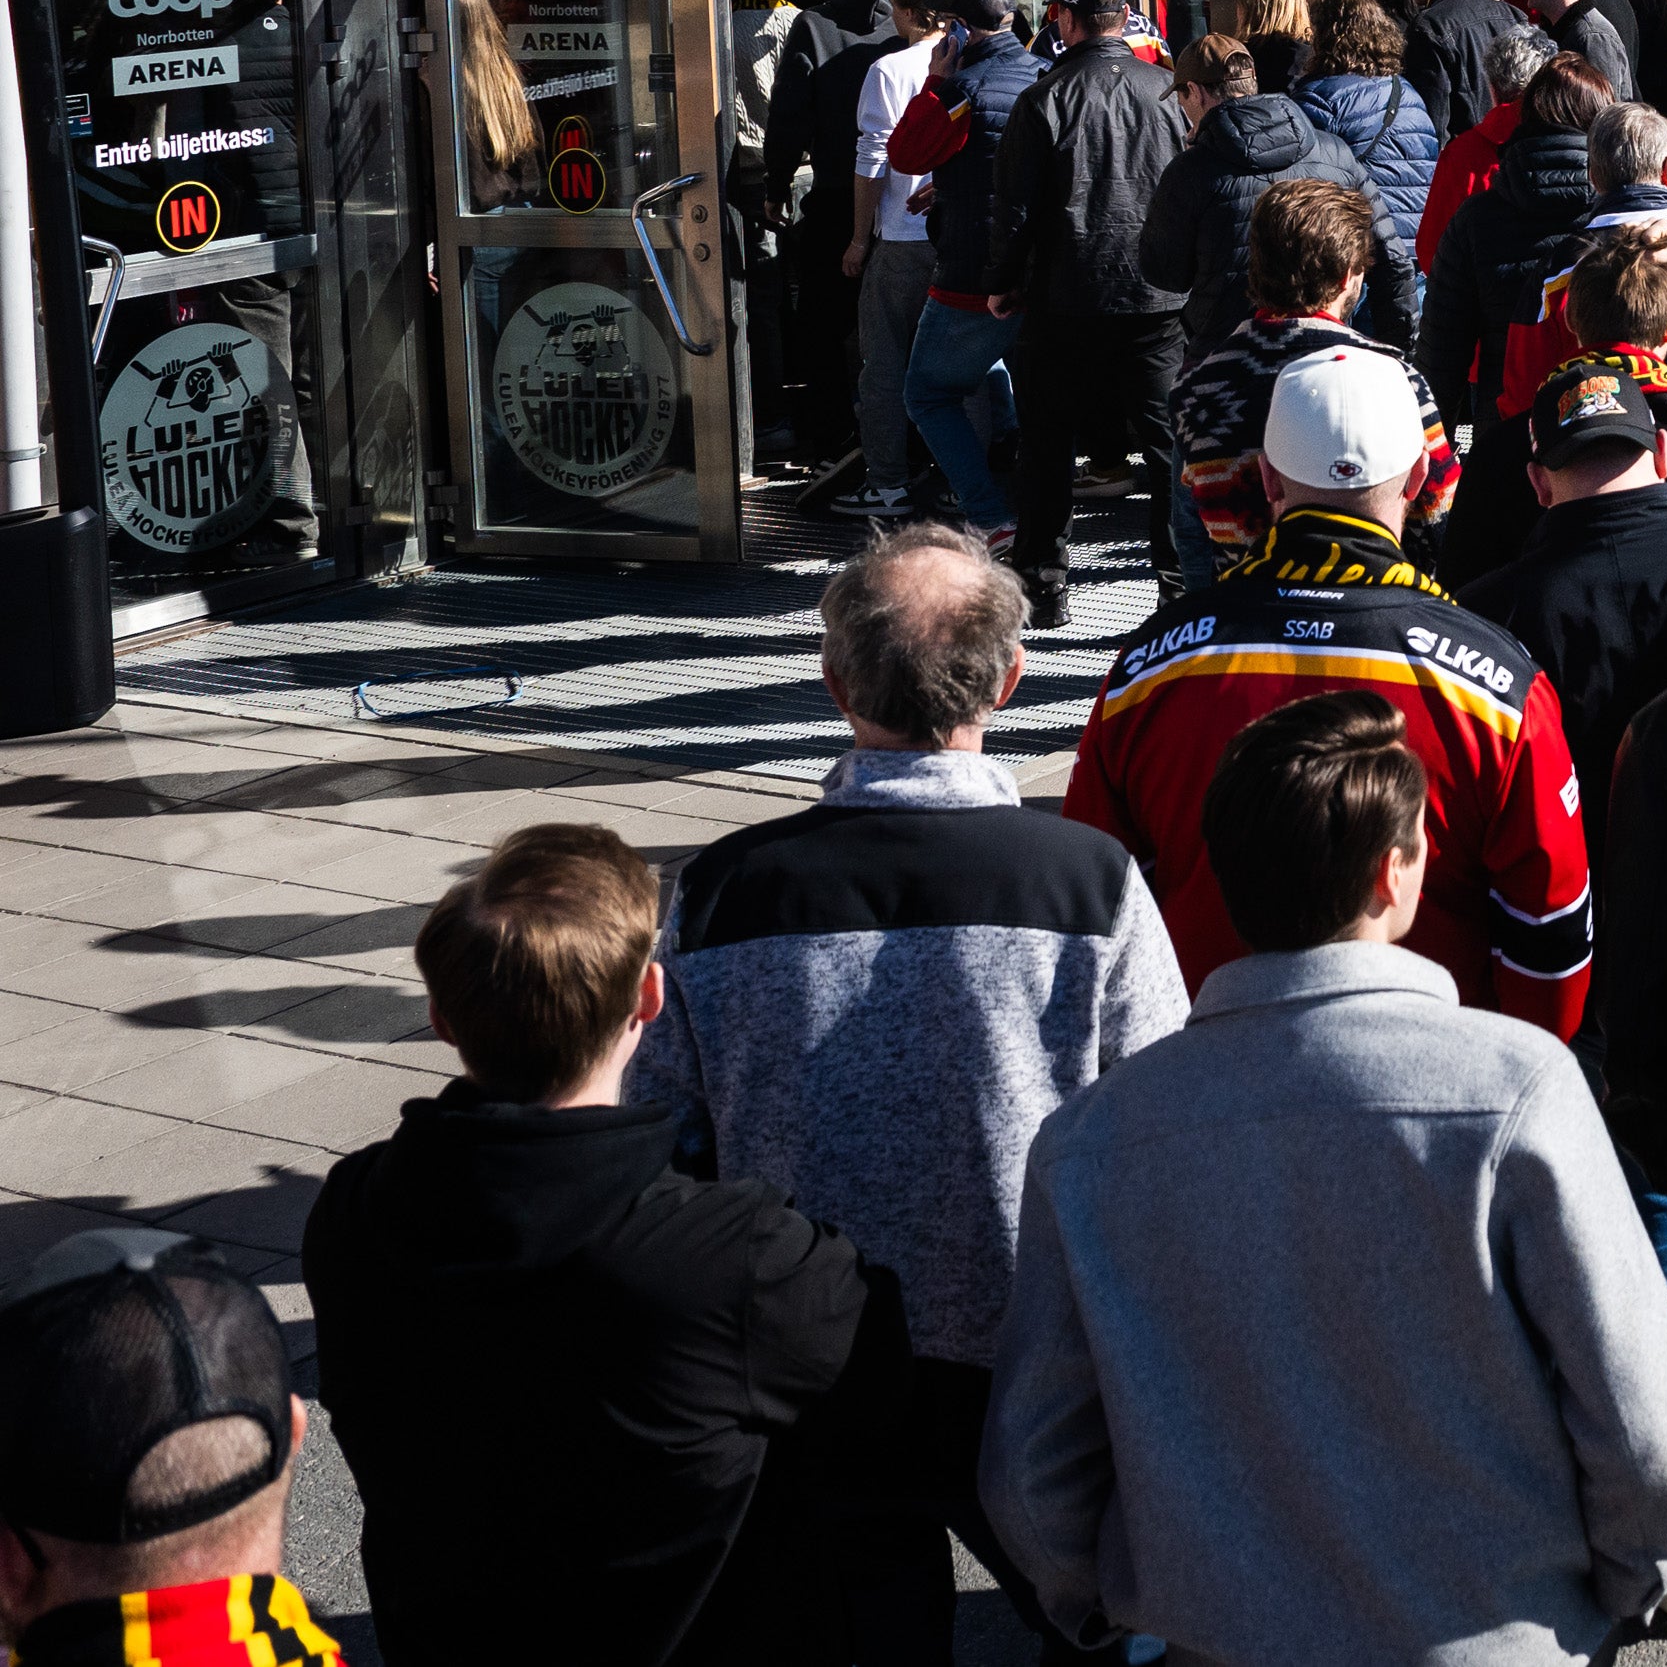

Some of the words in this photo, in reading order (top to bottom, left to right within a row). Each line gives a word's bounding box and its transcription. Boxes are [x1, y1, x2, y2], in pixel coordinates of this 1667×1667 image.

[528, 4, 598, 17] Norrbotten
[137, 28, 214, 46] Norrbotten
[521, 32, 609, 51] ARENA
[128, 56, 226, 85] ARENA
[95, 138, 152, 168] Entré
[156, 126, 274, 162] biljettkassa
[561, 163, 593, 198] IN
[170, 196, 207, 238] IN
[1287, 588, 1345, 601] BAUER
[1143, 614, 1217, 664] LKAB
[1283, 618, 1335, 640] SSAB
[1434, 637, 1515, 695] LKAB
